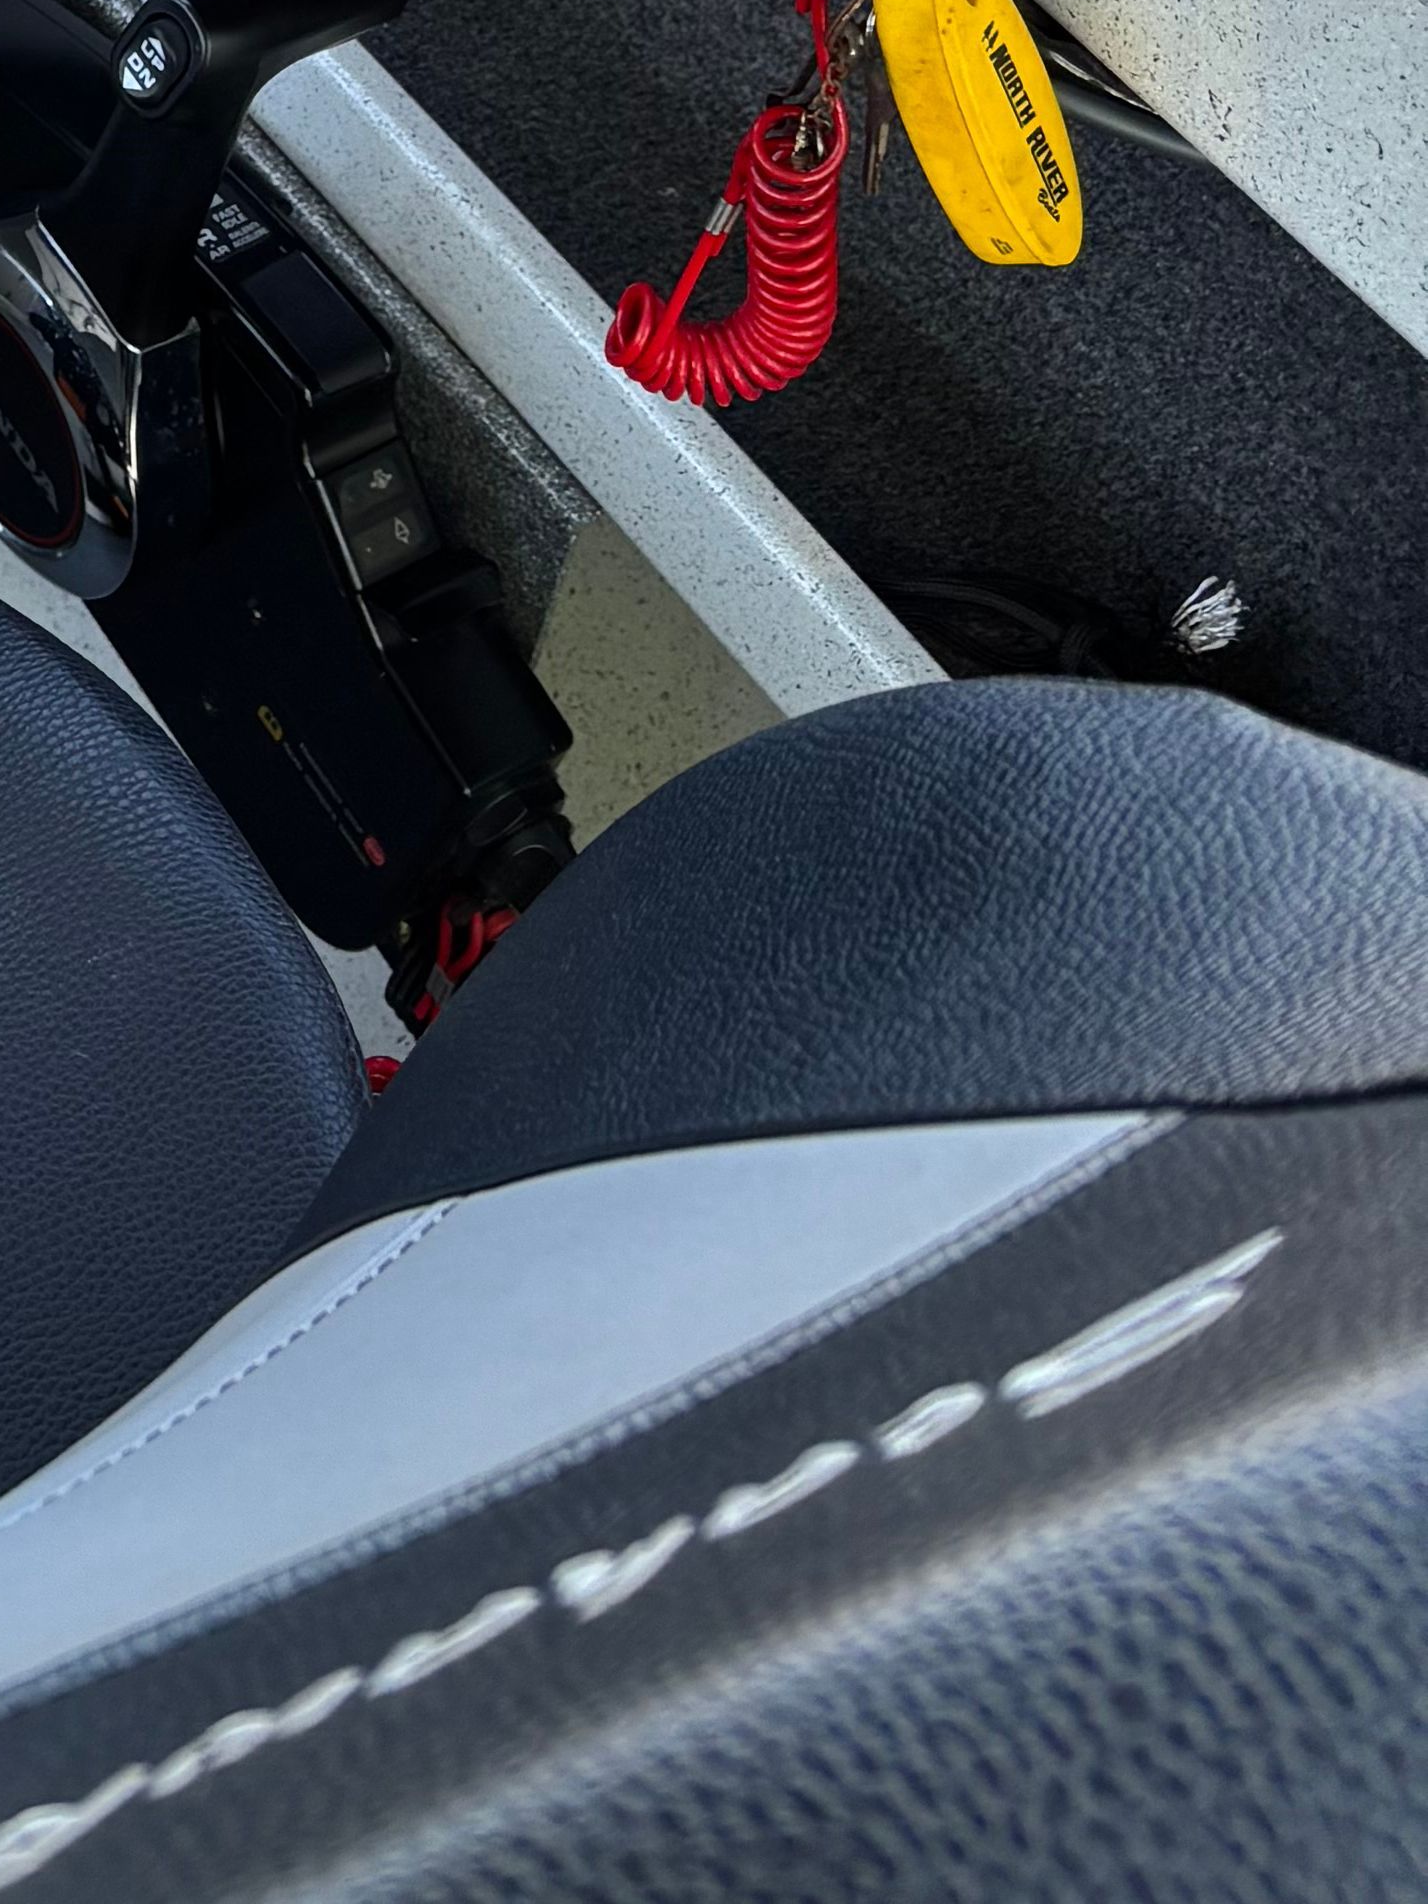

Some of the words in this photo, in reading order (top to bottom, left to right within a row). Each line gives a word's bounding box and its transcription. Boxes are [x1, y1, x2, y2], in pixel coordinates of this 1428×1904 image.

[127, 51, 156, 89] DN
[140, 39, 165, 72] UP
[988, 42, 1036, 129] NORTH
[1026, 125, 1069, 207] RIVER
